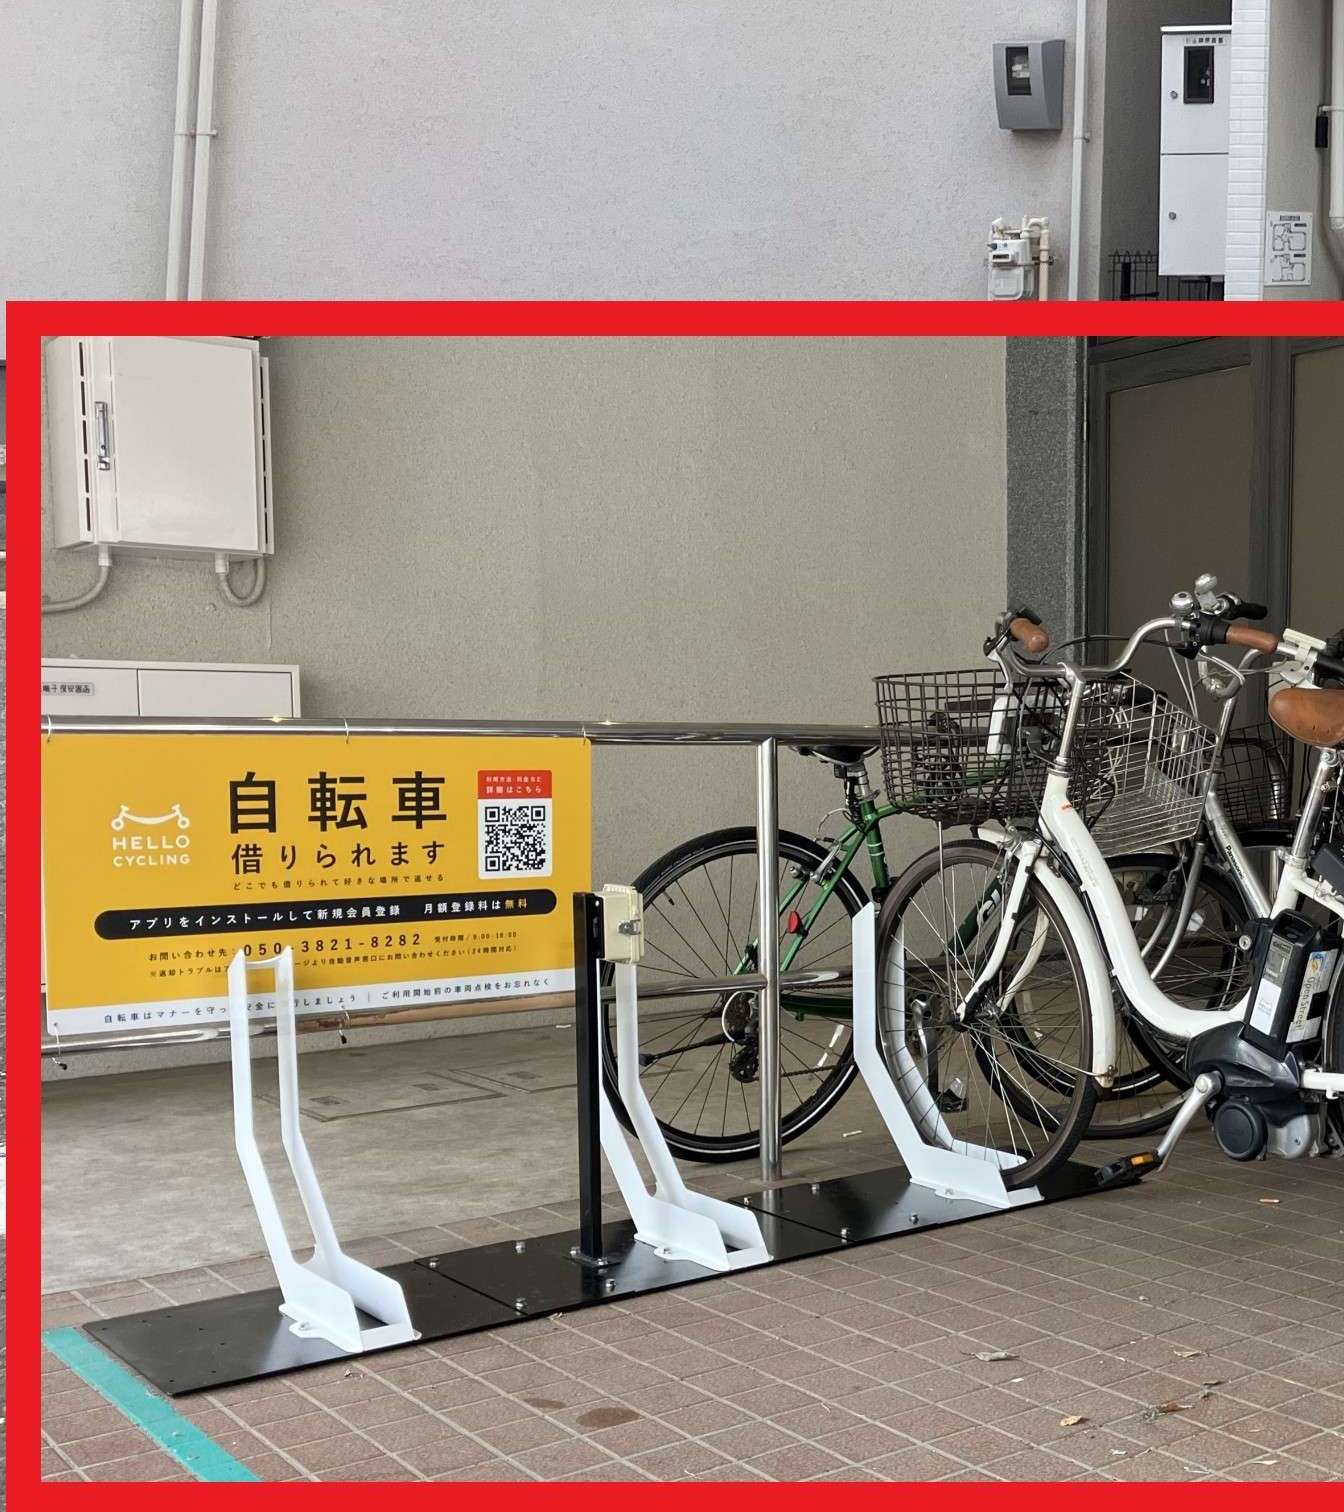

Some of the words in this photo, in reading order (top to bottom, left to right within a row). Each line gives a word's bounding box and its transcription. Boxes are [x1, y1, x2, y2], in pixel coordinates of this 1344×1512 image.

[229, 771, 447, 834] 自転車
[112, 835, 190, 850] HELLO
[231, 841, 444, 875] 借りられます
[113, 854, 190, 867] CYCLING
[129, 904, 401, 931] アプリをインストールして新規会員登録
[423, 898, 528, 915] 月額登録料は無料
